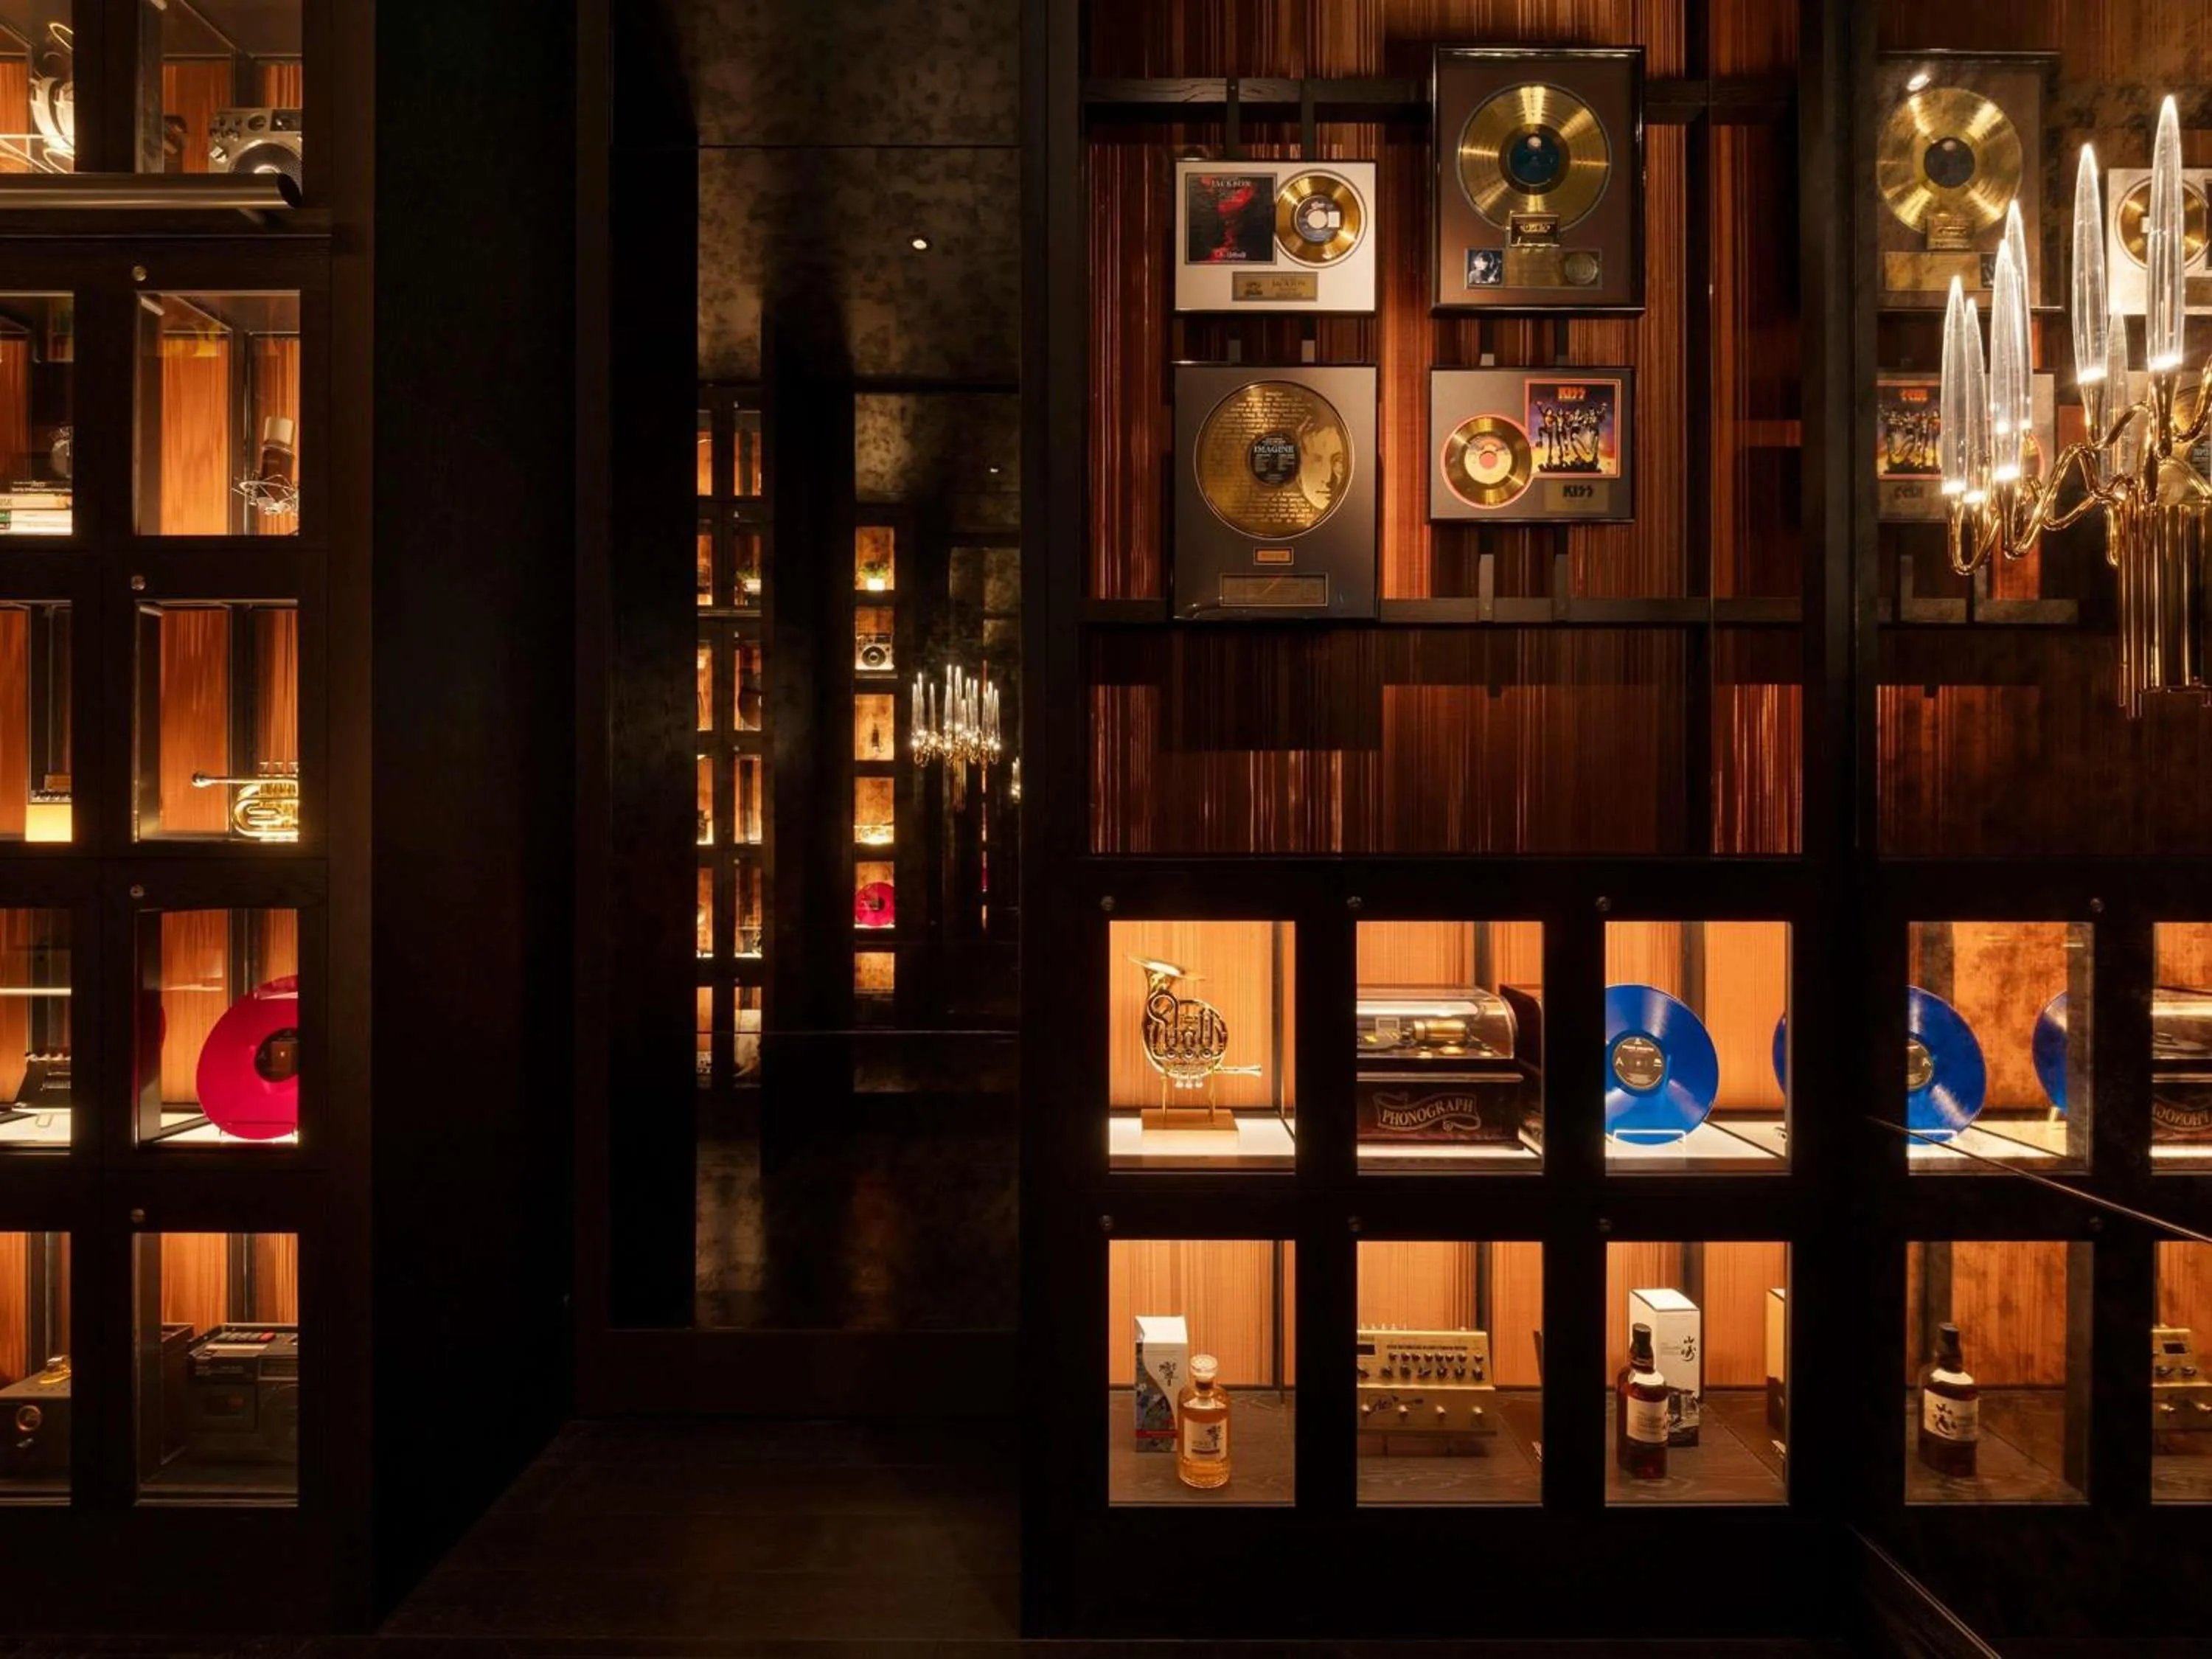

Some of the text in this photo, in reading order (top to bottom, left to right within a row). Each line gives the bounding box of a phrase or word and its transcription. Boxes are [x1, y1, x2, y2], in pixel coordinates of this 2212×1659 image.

[1558, 386, 1587, 400] KISS
[1253, 445, 1295, 453] IMAGINE
[1563, 484, 1594, 498] KISS
[1382, 1097, 1473, 1126] PHONOGRAPH
